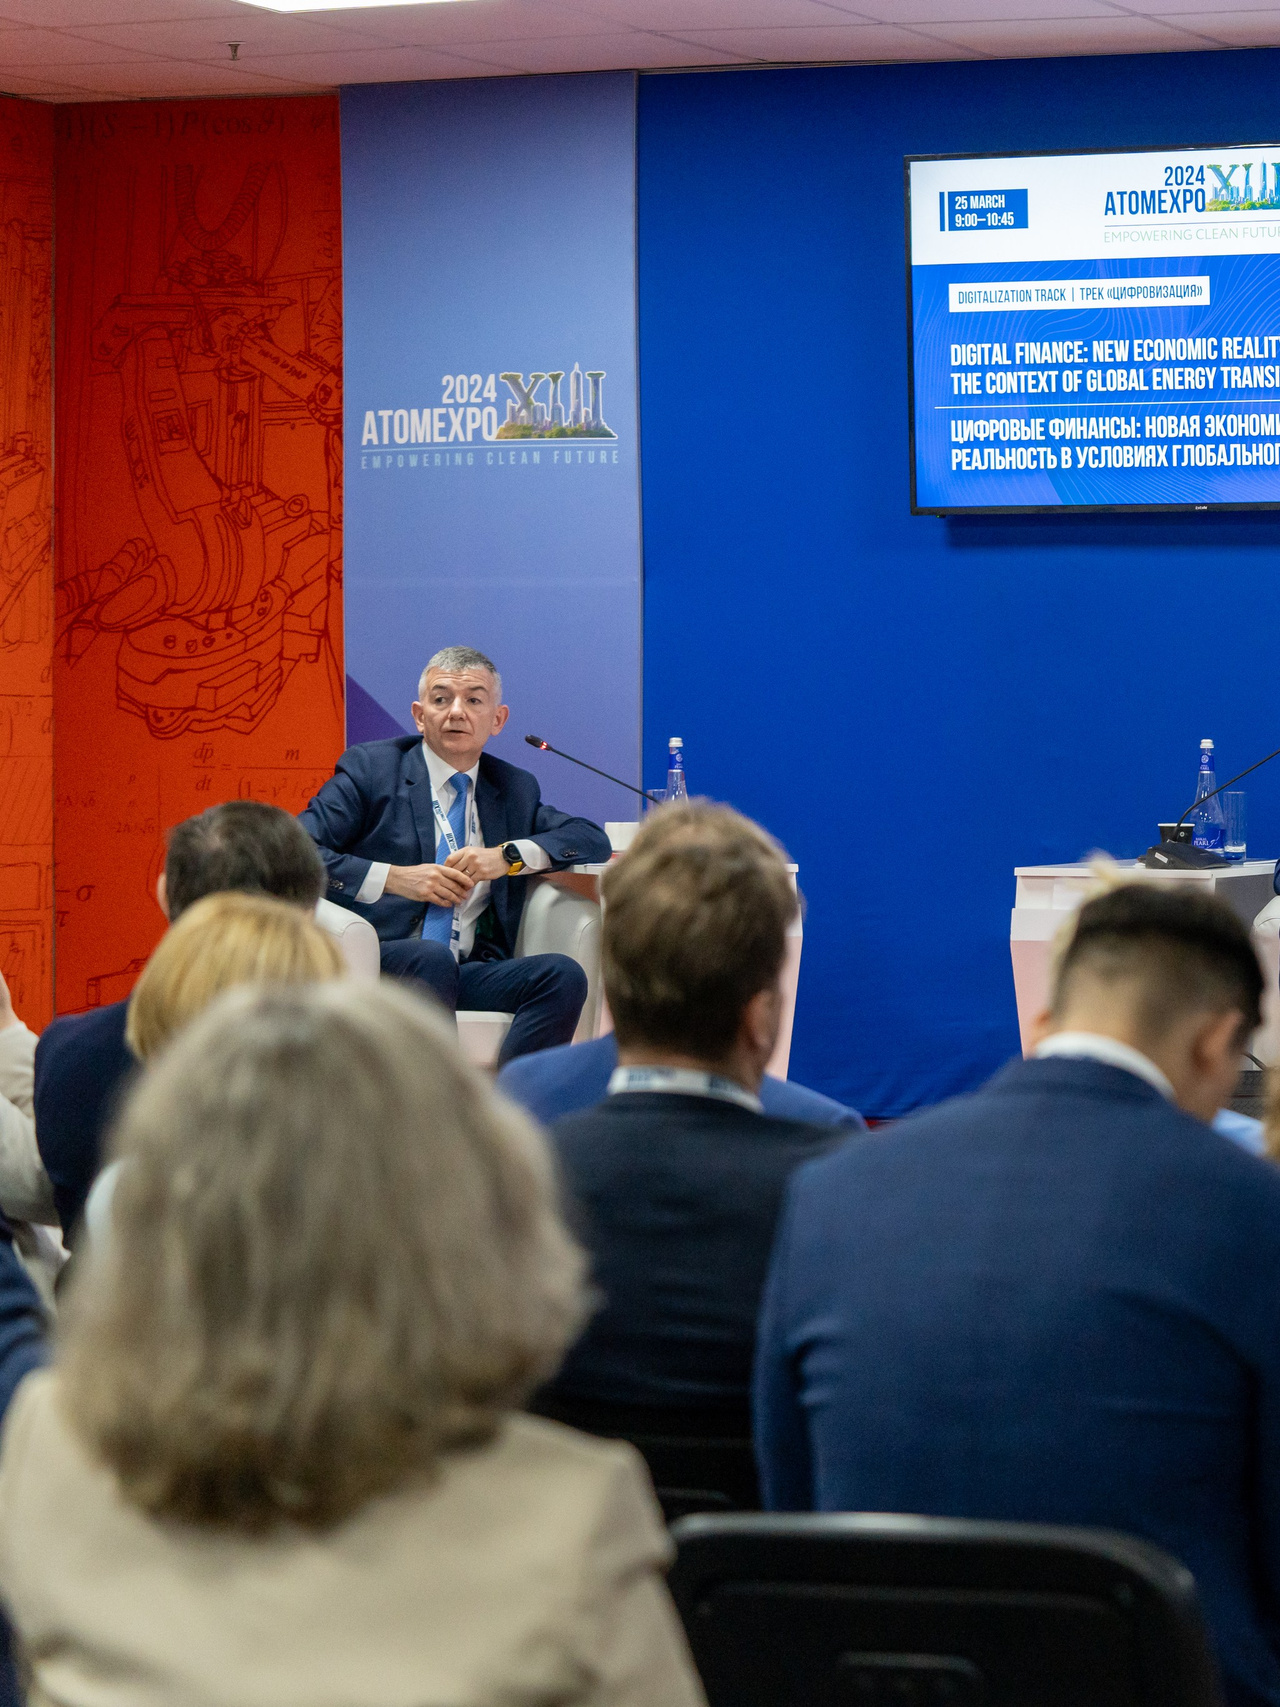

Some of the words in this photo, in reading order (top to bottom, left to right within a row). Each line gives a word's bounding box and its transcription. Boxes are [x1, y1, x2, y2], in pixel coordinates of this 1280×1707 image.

[1164, 165, 1206, 187] 2024
[954, 195, 968, 210] 25
[970, 194, 1006, 210] MARCH
[1104, 188, 1206, 216] ATOMEXPO
[1104, 228, 1193, 244] EMPOWERING
[1195, 227, 1239, 241] CLEAN
[958, 289, 1032, 304] DIGITALIZATION
[1035, 288, 1067, 303] TRACK
[1079, 286, 1105, 301] ТРЕК
[1106, 284, 1203, 301] «ЦИФРОВИЗАЦИЯ»
[950, 342, 1012, 366] DIGITAL
[1015, 340, 1089, 365] FINANCE:
[1092, 339, 1130, 363] NEW
[1133, 337, 1218, 362] ECONOMIC
[441, 374, 497, 404] 2024
[950, 372, 982, 395] THE
[985, 370, 1059, 395] CONTEXT
[1062, 369, 1083, 393] OF
[1086, 367, 1149, 392] GLOBAL
[1152, 366, 1217, 391] ENERGY
[361, 406, 498, 445] ATOMEXPO
[951, 418, 1046, 444] ЦИФРОВЫЕ
[1048, 416, 1141, 440] ФИНАНСЫ:
[1145, 415, 1201, 439] НОВАЯ
[361, 452, 474, 469] EMPOWERING
[487, 451, 541, 465] CLEAN
[554, 450, 619, 465] FUTURE
[951, 447, 1058, 471] РЕАЛЬНОСТЬ
[1060, 446, 1073, 470] В
[1075, 444, 1169, 469] УСЛОВИЯХ
